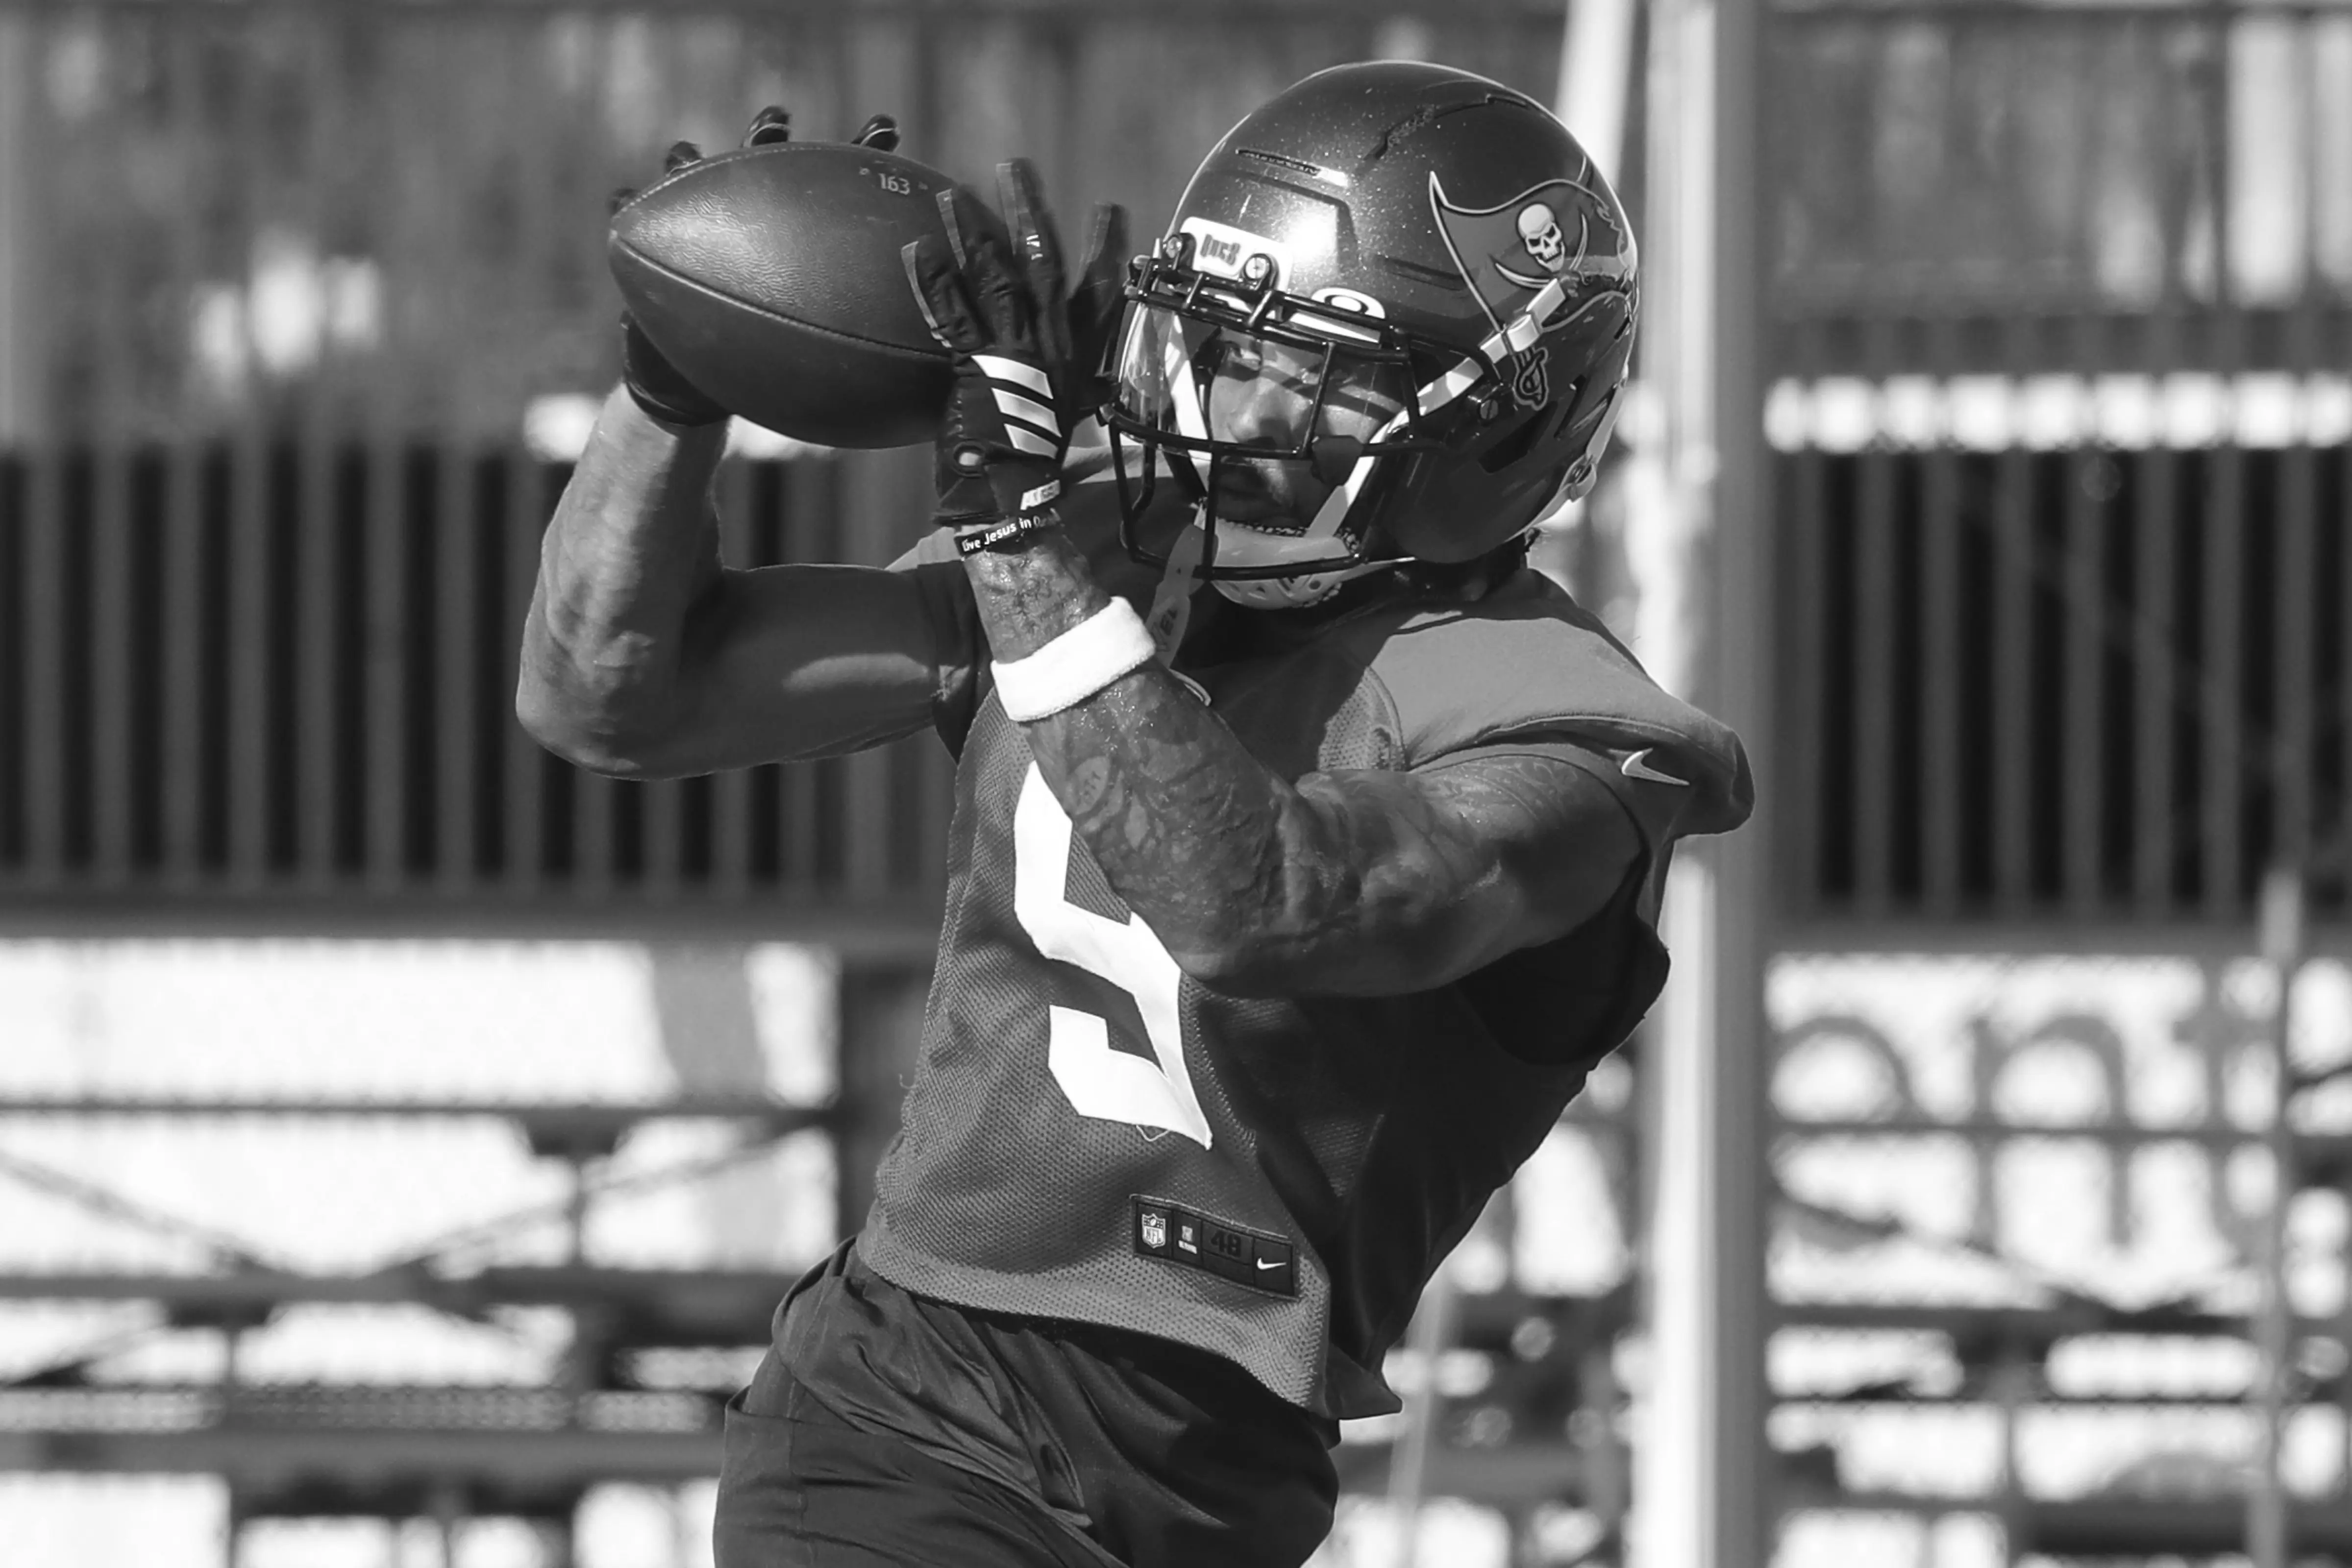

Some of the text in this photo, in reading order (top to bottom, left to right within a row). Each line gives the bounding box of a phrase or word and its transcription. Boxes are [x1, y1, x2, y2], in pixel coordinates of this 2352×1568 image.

[878, 173, 910, 195] 163
[984, 522, 1017, 545] Jesus
[1019, 517, 1032, 529] in
[1211, 1230, 1241, 1257] 48
